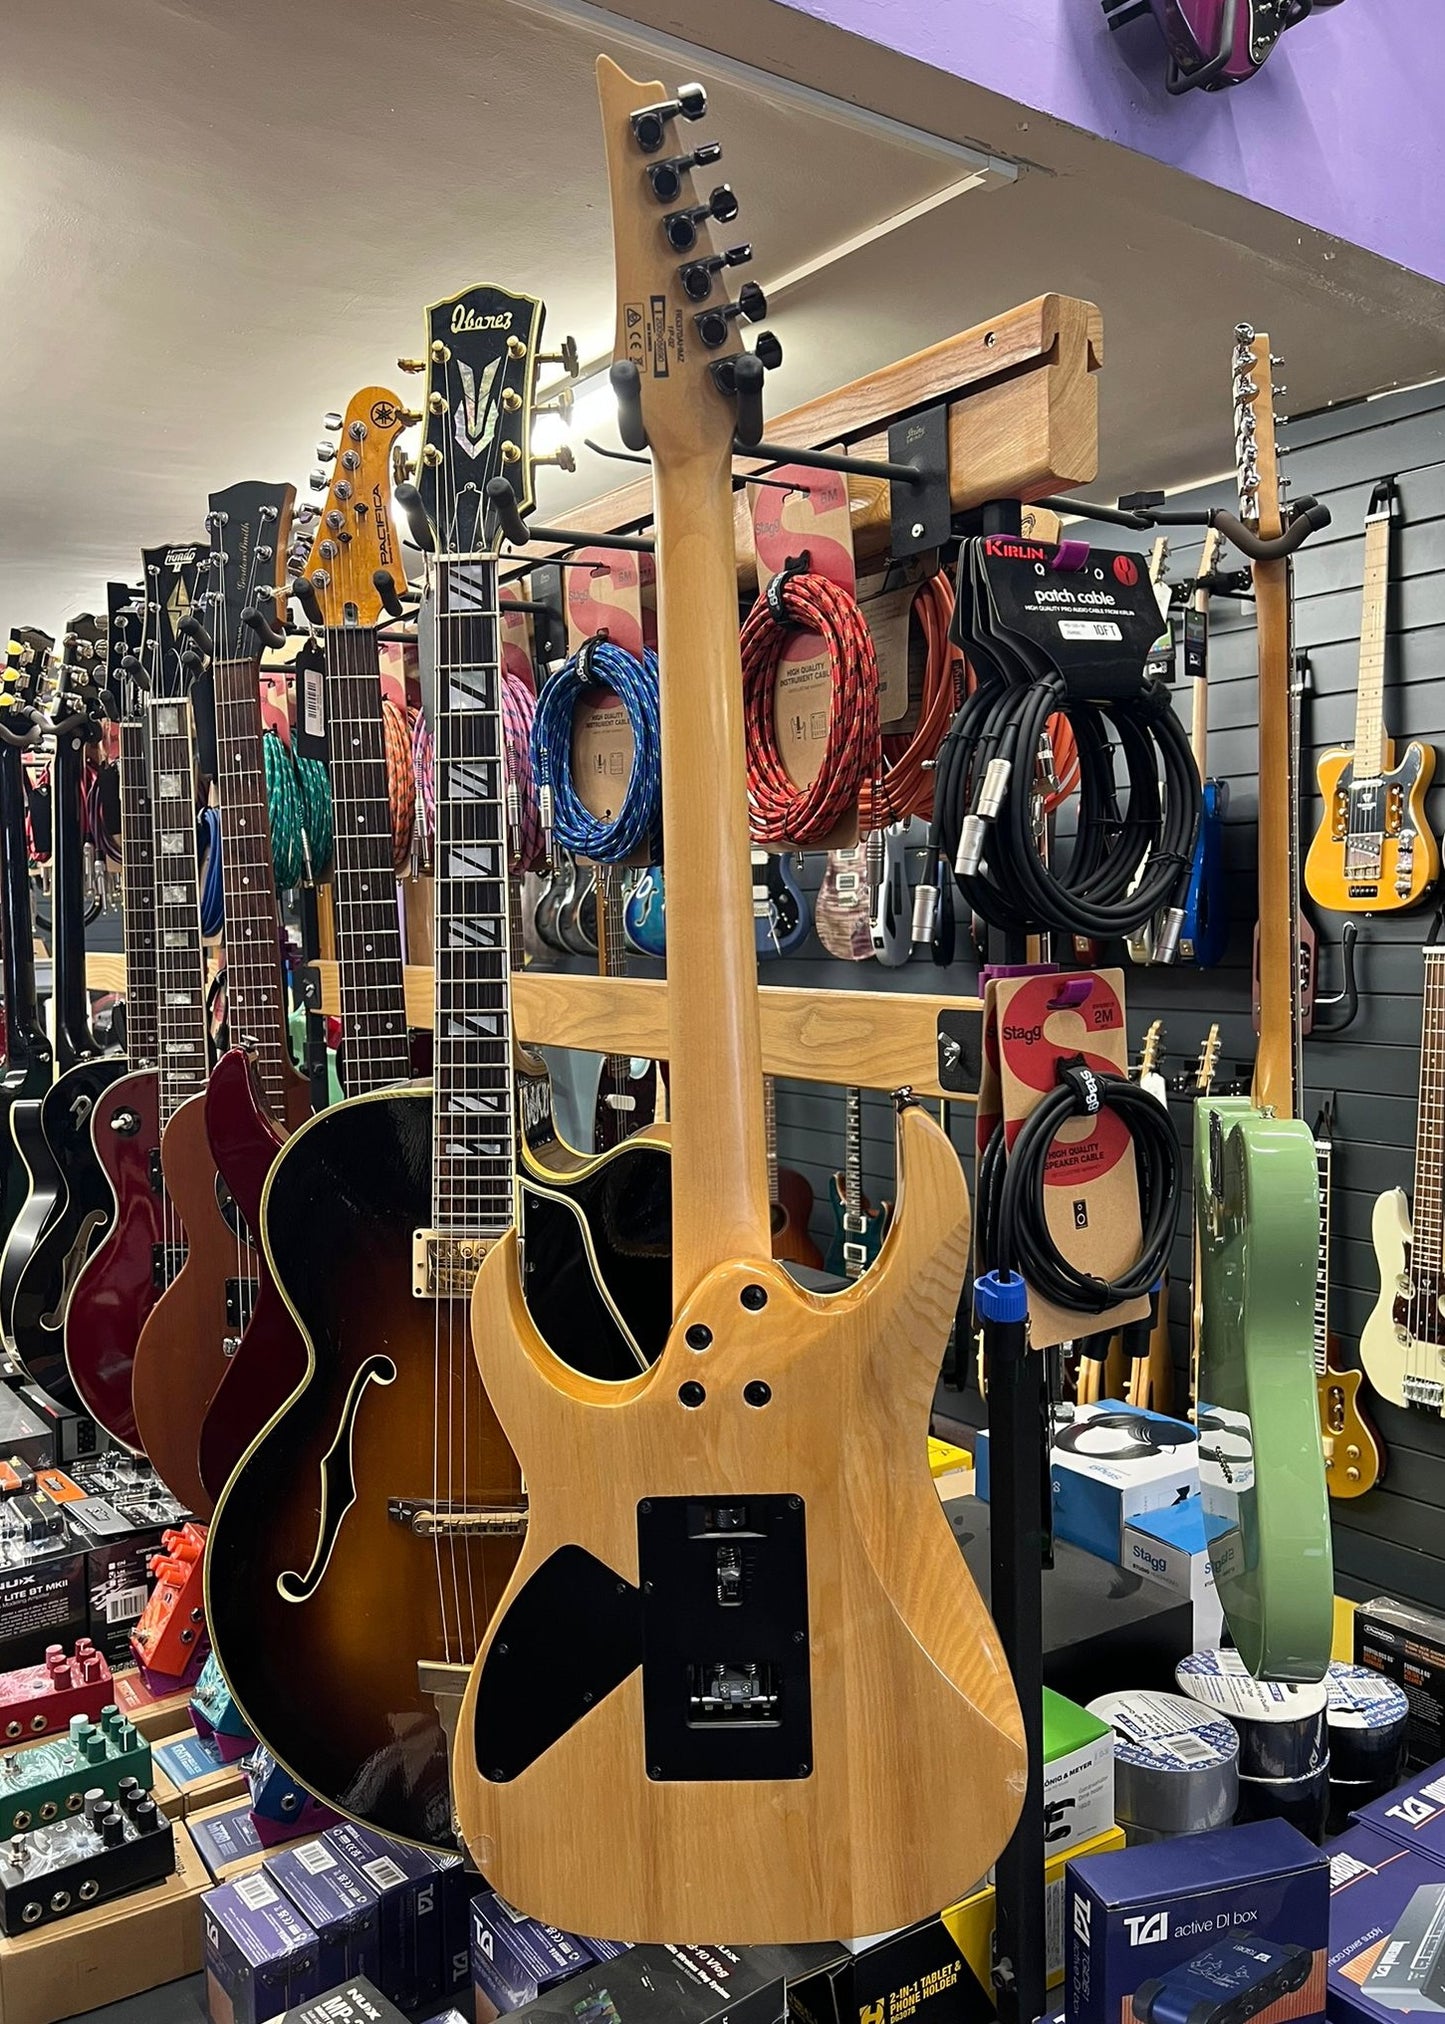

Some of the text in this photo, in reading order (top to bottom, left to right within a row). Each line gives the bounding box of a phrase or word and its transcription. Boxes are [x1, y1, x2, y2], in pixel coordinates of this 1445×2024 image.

[450, 303, 513, 335] Ibanez
[372, 483, 390, 566] PACIFICA
[756, 518, 780, 537] Stagg
[985, 539, 1044, 560] KIRLIN
[1034, 588, 1116, 606] patch cable
[1024, 604, 1038, 612] HIGH
[1060, 605, 1072, 613] PRO
[1073, 606, 1089, 614] AUDIO
[1089, 607, 1104, 615] CABLE
[1093, 624, 1116, 637] 10FT
[780, 673, 814, 688] INSTRUMENT
[814, 670, 830, 680] CABL
[786, 662, 824, 677] HIGH QUALITY
[1094, 1009, 1113, 1024] 2M
[1003, 1025, 1042, 1045] Stagg
[1080, 1069, 1100, 1112] stagg
[1044, 1151, 1105, 1170] SPEAKER CABLE
[1048, 1143, 1100, 1159] HIGH QUALITY
[1133, 1545, 1167, 1572] Stagg
[5, 1579, 69, 1602] LITE BT MKII
[1197, 1726, 1228, 1740] EAGLE
[1121, 1741, 1151, 1755] EAGLE
[1044, 1775, 1062, 1787] ÖNIG
[1069, 1760, 1092, 1776] MEYER
[1384, 1796, 1437, 1825] TGI
[1074, 1892, 1091, 1948] TGI
[1124, 1910, 1258, 1947] TGI active DI box
[715, 1944, 741, 1963] UX
[706, 1957, 730, 1978] Vlog
[709, 1980, 731, 2000] System
[889, 1960, 962, 2004] 2-IN-1 TABLET &
[346, 1987, 382, 2021] NUX
[889, 1973, 957, 2015] PHONE HOLDER
